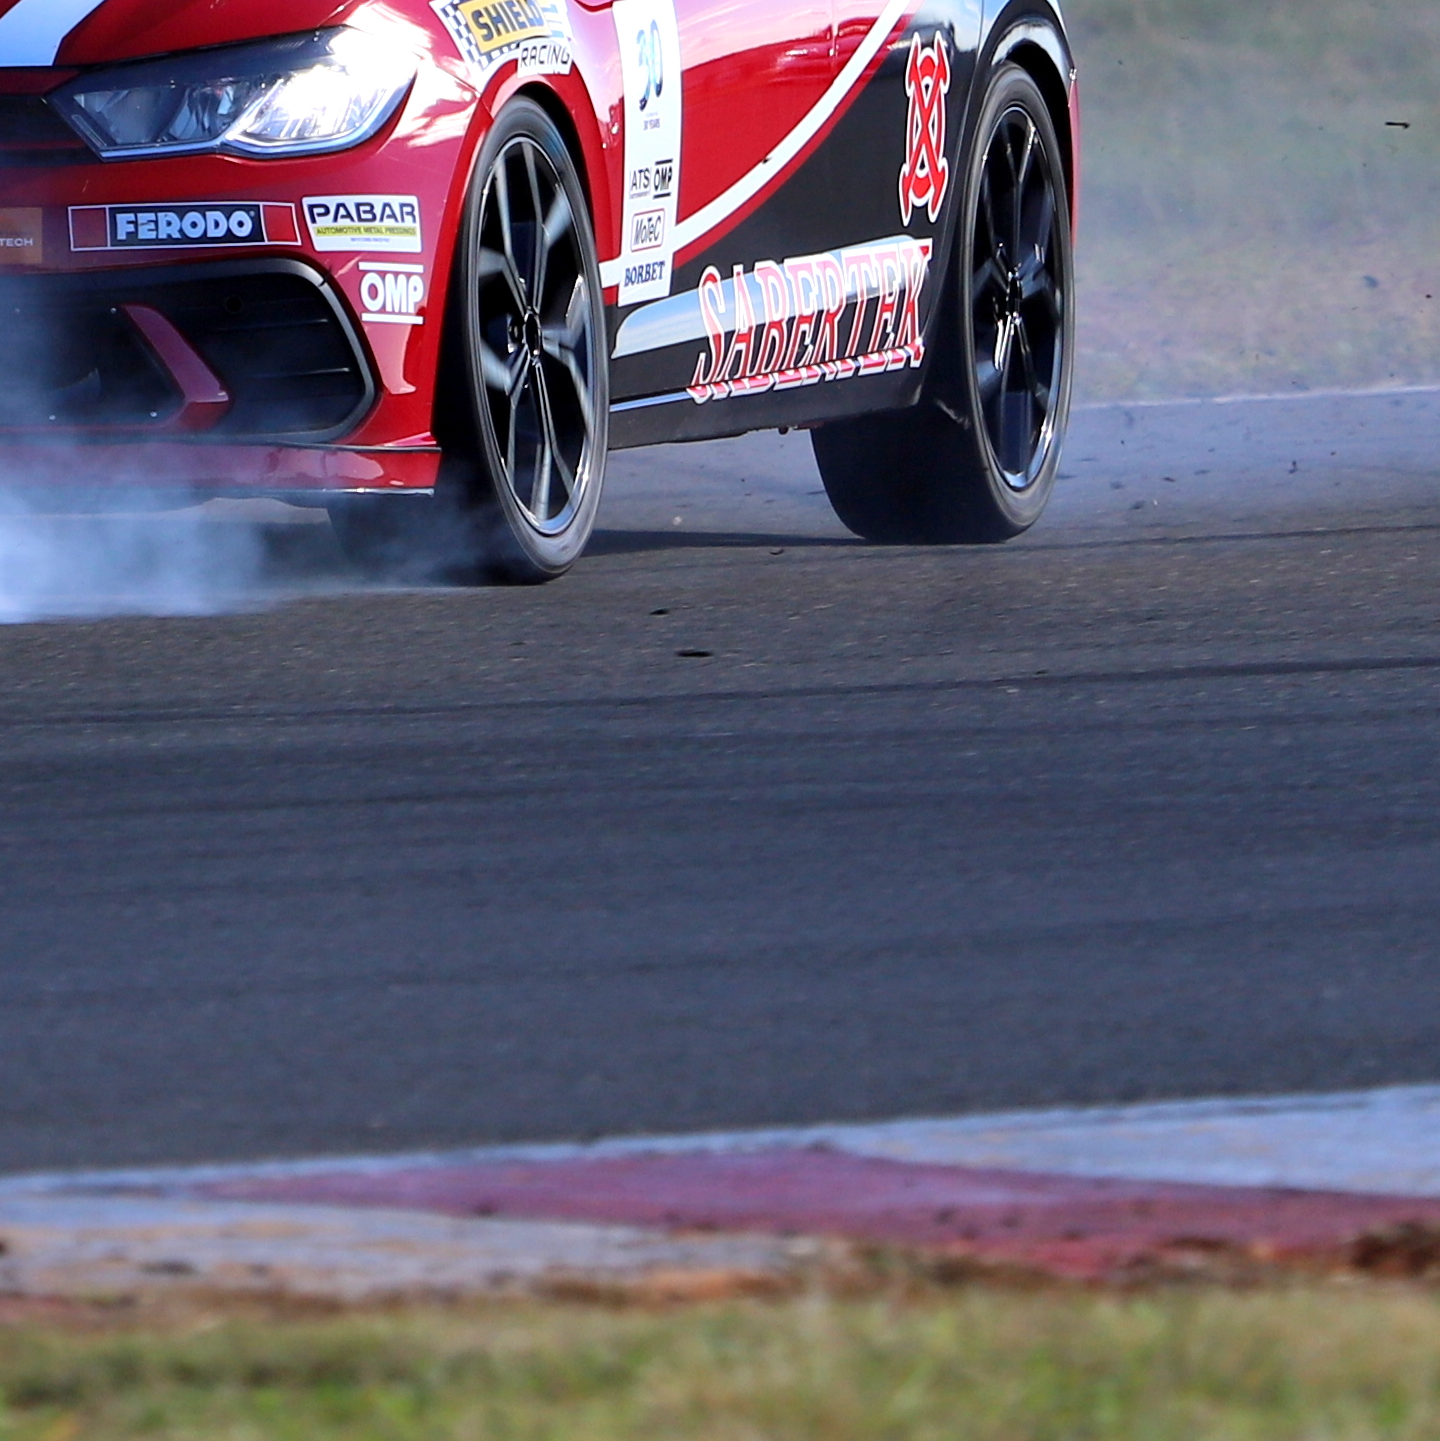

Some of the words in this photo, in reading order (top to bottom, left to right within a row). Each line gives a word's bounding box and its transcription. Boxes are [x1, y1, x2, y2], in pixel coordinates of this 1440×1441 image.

[521, 42, 570, 67] RACING
[631, 168, 650, 190] ATS
[116, 210, 253, 240] FERODO
[307, 202, 417, 224] PABAR
[624, 261, 665, 287] BORBET
[360, 272, 424, 313] OMP
[686, 238, 932, 404] SABERTEK
